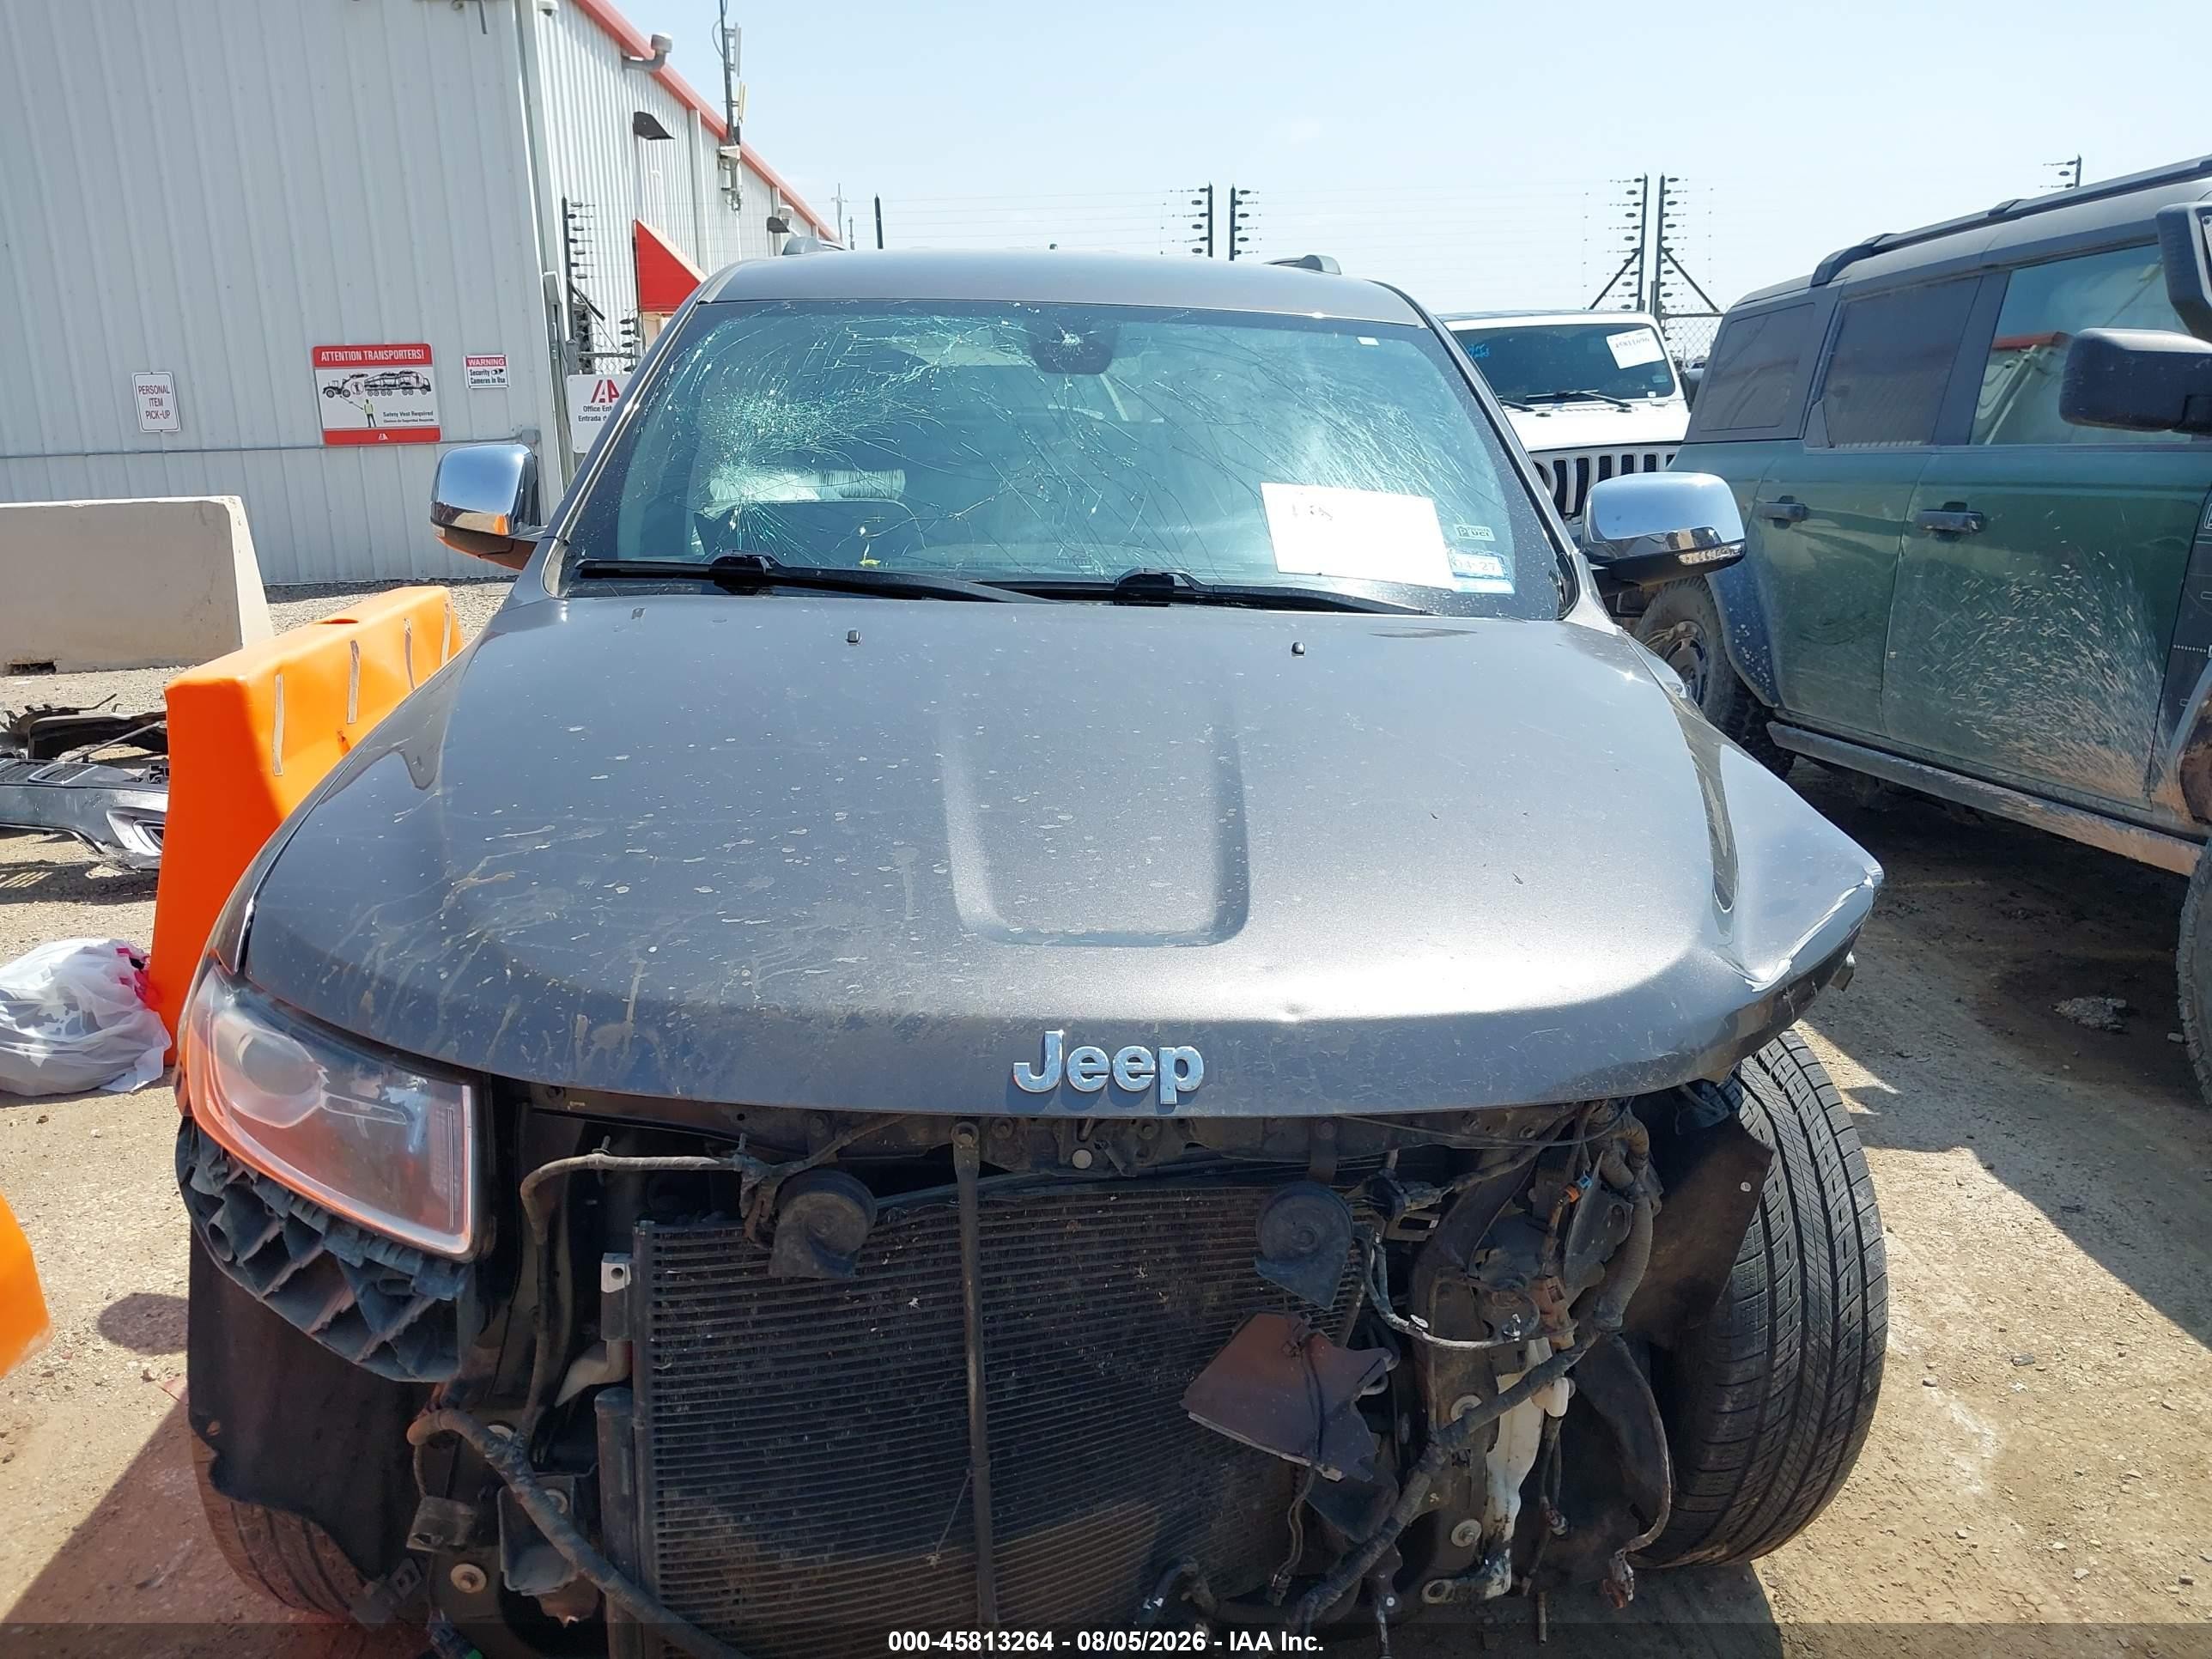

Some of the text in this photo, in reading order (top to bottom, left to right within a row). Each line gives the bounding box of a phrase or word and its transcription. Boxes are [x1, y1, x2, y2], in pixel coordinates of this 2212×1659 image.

[321, 349, 425, 362] ATTENTION TRANSPORTERS!
[138, 385, 171, 395] PERSONAL
[149, 398, 164, 407] ITEM
[145, 410, 171, 420] PICK-UP
[1013, 1030, 1204, 1105] Jeep
